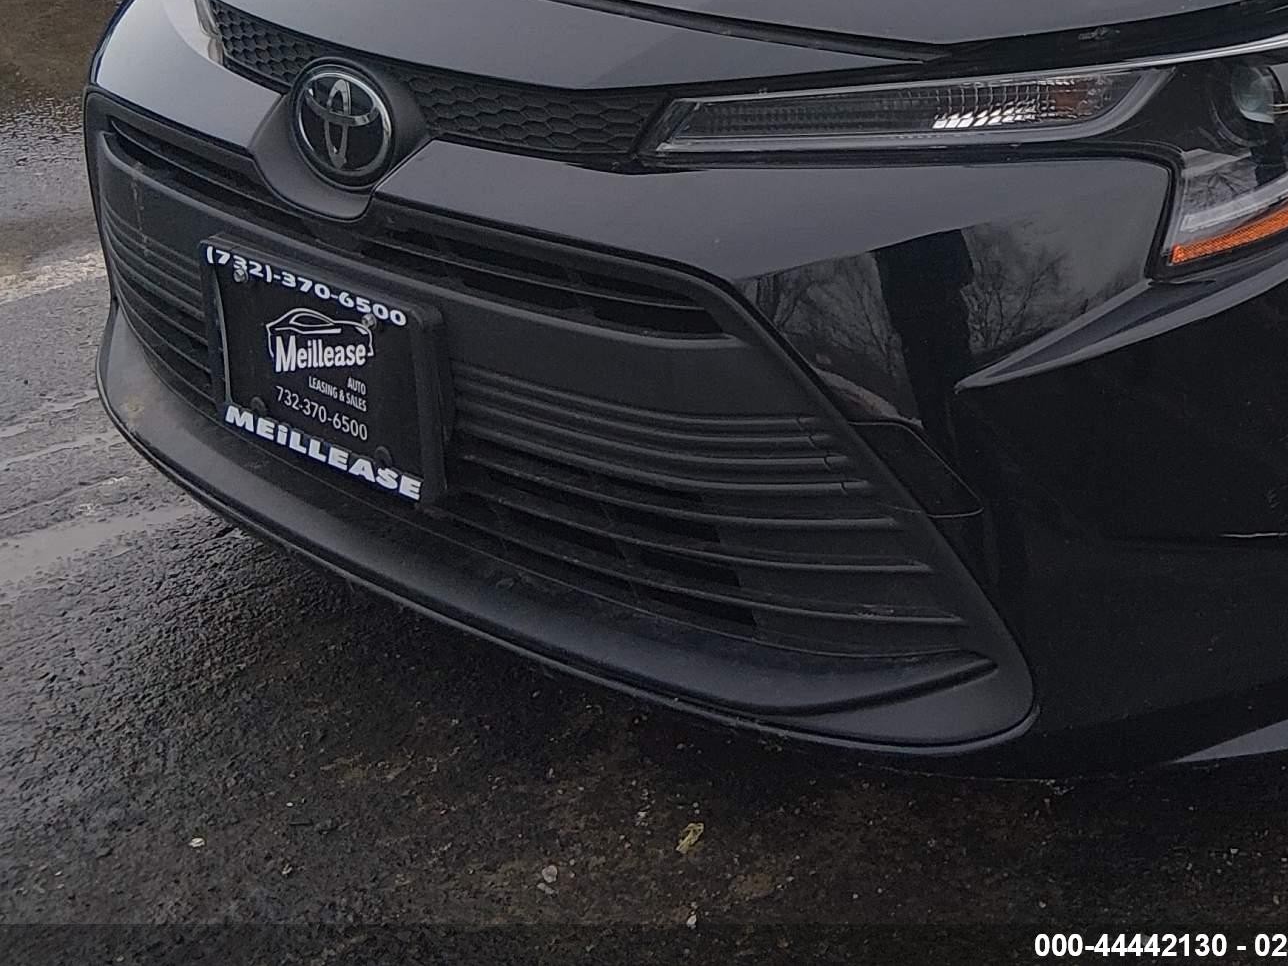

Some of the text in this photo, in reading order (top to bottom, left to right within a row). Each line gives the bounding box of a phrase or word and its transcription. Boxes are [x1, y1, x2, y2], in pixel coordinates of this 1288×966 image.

[206, 246, 408, 327] (732)-370-6500
[275, 335, 367, 372] Meillease
[308, 376, 367, 412] LEASING & SALES
[347, 376, 366, 395] AUTO
[275, 385, 368, 441] 732-370-6500
